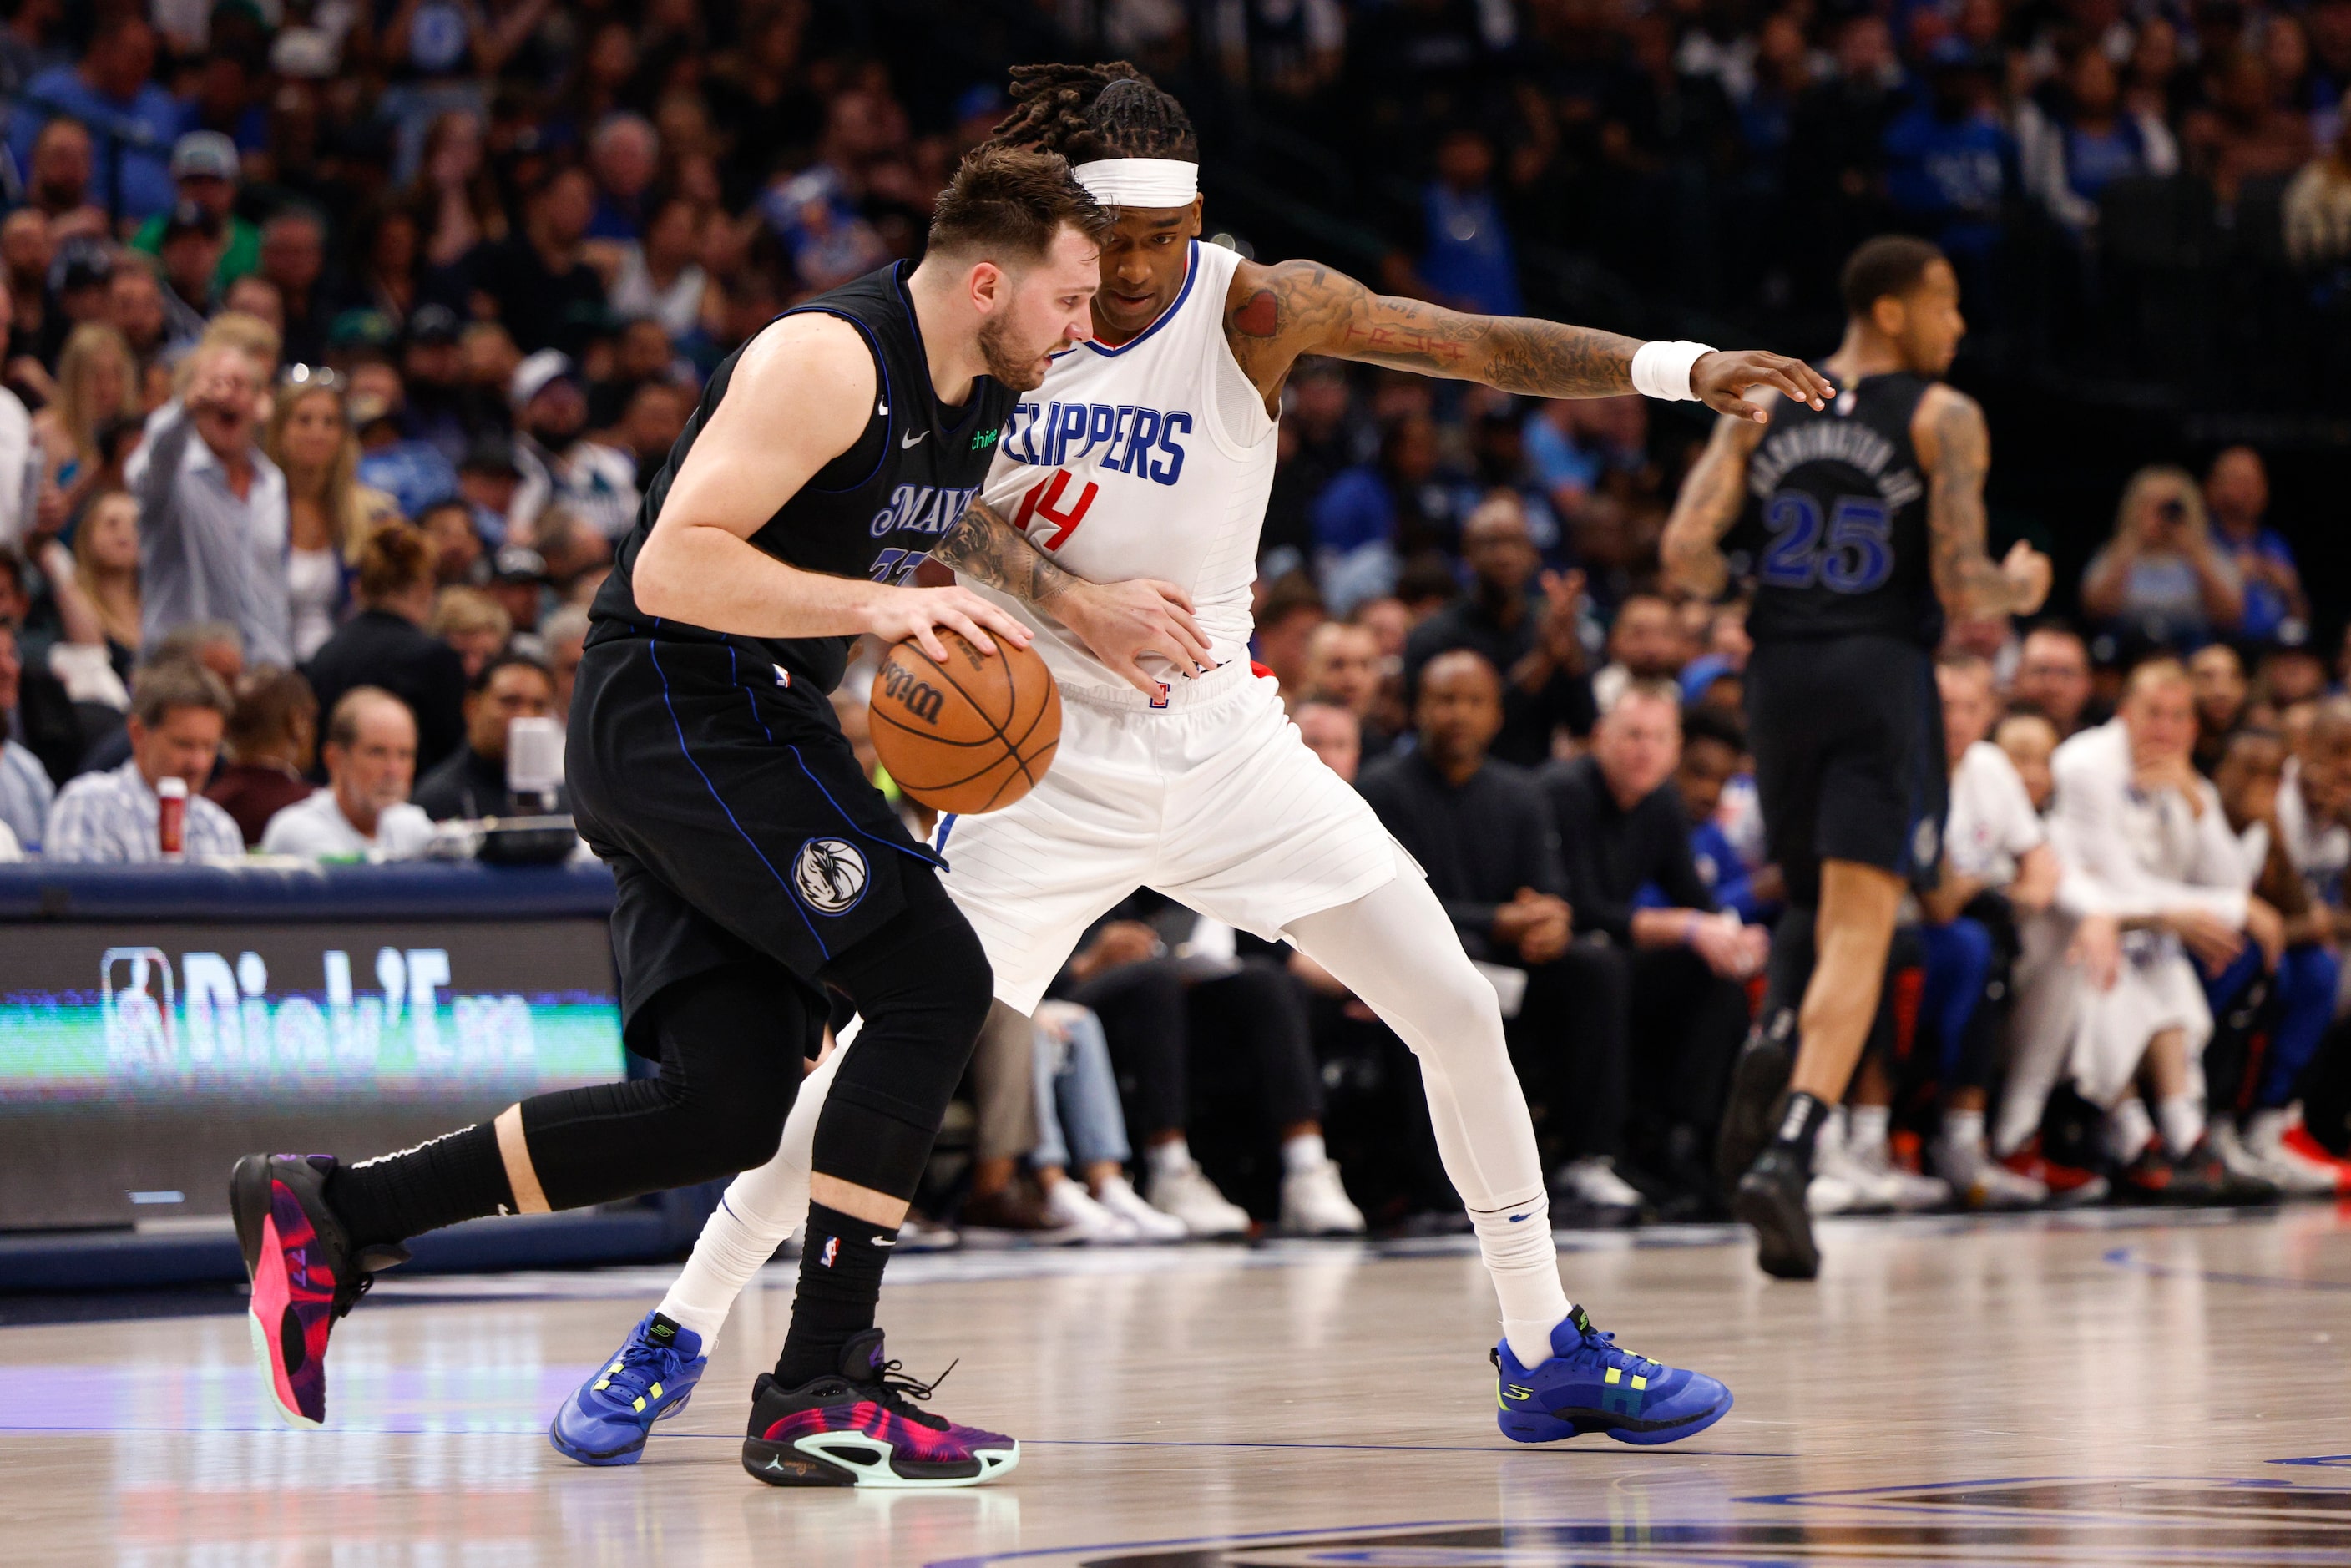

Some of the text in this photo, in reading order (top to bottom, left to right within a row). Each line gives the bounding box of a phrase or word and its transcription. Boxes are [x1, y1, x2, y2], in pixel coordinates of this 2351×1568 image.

[1001, 401, 1193, 486] CLIPPERS
[1014, 468, 1099, 552] 14
[1761, 488, 1895, 594] 25
[869, 547, 933, 587] 77
